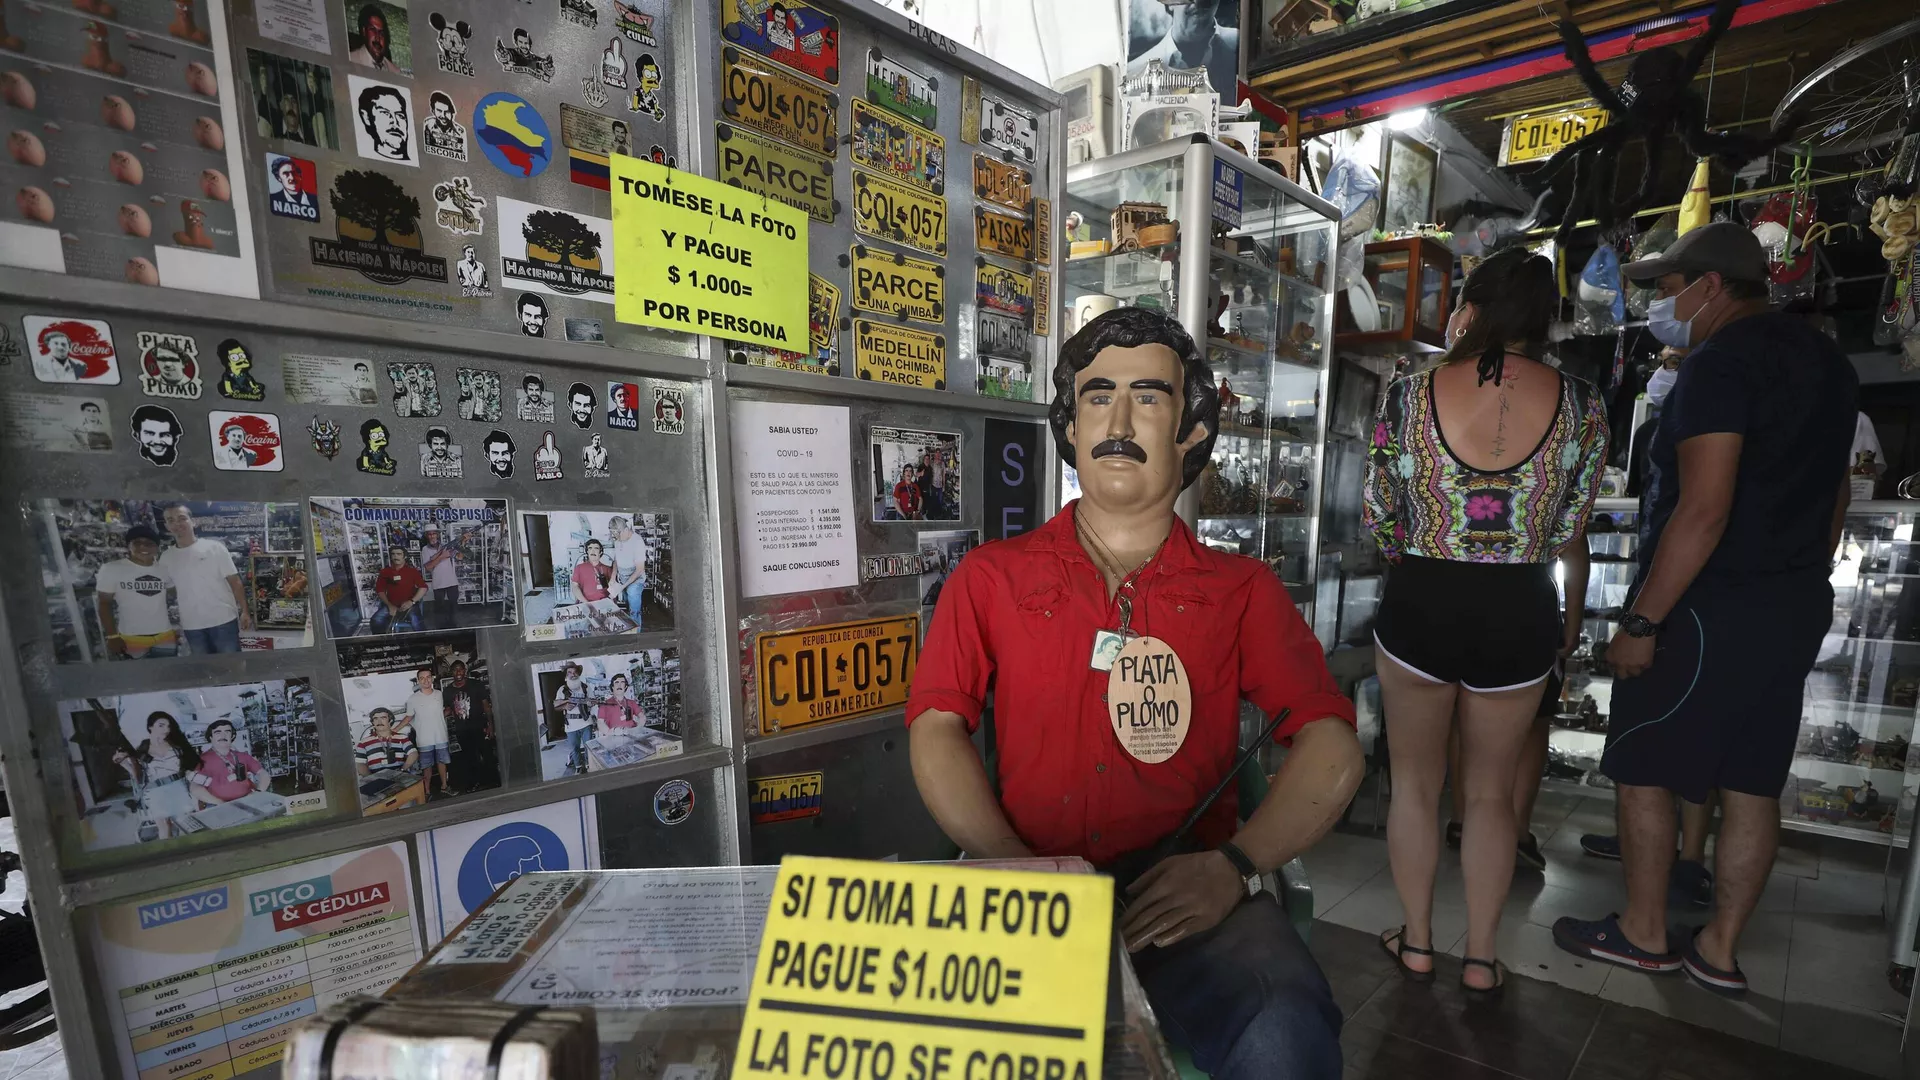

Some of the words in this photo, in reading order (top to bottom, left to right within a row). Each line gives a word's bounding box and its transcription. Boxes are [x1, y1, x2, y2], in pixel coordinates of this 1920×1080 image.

[626, 30, 656, 47] CULITO
[908, 19, 957, 54] PLACAS
[439, 61, 475, 77] POLICE
[788, 78, 820, 96] COLOMBIA
[729, 69, 781, 120] COL
[793, 95, 832, 140] 057
[1155, 96, 1188, 105] HACIENDA
[744, 116, 783, 136] AMERICA
[785, 132, 800, 143] DEL
[804, 138, 820, 151] SUR
[905, 126, 932, 141] COLOMBIA
[992, 128, 1026, 149] COLOMBIA
[1515, 120, 1553, 150] COL
[1561, 114, 1603, 144] 057
[425, 145, 466, 162] ESCOBAR
[784, 149, 816, 164] COLOMBIA
[724, 147, 827, 201] PARCE
[866, 160, 900, 177] AMERICA
[916, 178, 931, 190] SUR
[273, 199, 317, 219] NARCO
[619, 176, 712, 216] TOMESE
[720, 203, 744, 224] LA
[751, 212, 796, 240] FOTO
[907, 191, 933, 204] COLOMBIA
[437, 209, 481, 234] STUNT
[859, 187, 900, 228] COL
[911, 204, 942, 240] 057
[979, 217, 1030, 249] PAISAS
[1039, 203, 1048, 259] COLOMBIA
[661, 229, 677, 248] Y
[684, 235, 752, 267] PAGUE
[919, 242, 932, 251] SUR
[314, 241, 383, 269] HACIENDA
[389, 252, 444, 278] NAPOLES
[505, 259, 566, 282] HACIENDA
[571, 272, 615, 291] NAPOLE
[668, 265, 680, 285] $
[688, 271, 752, 296] 1.000=
[858, 267, 938, 302] PARCE
[980, 272, 1030, 302] COLOMBIA
[307, 287, 453, 312] WWW.HACIENDANAPOLES.COM
[868, 298, 890, 311] UNA
[892, 302, 932, 319] CHIMBA
[1038, 276, 1047, 330] COLOMBIA
[644, 299, 690, 323] POR
[697, 309, 787, 342] PERSONA
[142, 334, 193, 353] PLATA
[907, 332, 932, 342] COLOMBIA
[981, 319, 1002, 347] COL
[1009, 325, 1030, 350] 057
[71, 343, 110, 355] Cocaine
[860, 335, 941, 363] MEDELLÍN
[748, 357, 787, 369] AMERICA
[789, 363, 806, 372] DEL
[808, 366, 824, 375] SUR
[869, 354, 893, 368] UNA
[895, 359, 937, 375] CHIMBA
[148, 380, 198, 397] PLOMO
[882, 370, 923, 386] PARCE
[656, 389, 683, 401] PLATA
[609, 416, 637, 429] NARCO
[656, 421, 682, 434] PLOMO
[769, 426, 790, 434] SABIA
[244, 434, 277, 445] Cocaine
[536, 472, 563, 481] PABLO
[344, 508, 430, 521] COMANDANTE
[436, 508, 493, 520] CASPUSIA
[763, 563, 787, 572] SAQUE
[789, 560, 840, 570] CONCLUSIONES
[866, 555, 923, 579] COLOMBIA
[802, 632, 842, 647] REPUBLICA
[843, 631, 851, 641] DE
[853, 626, 884, 640] COLOMBIA
[768, 647, 840, 706] COL
[853, 635, 913, 691] 057
[1118, 654, 1178, 684] PLATA
[809, 690, 883, 718] SURAMERICA
[1144, 685, 1155, 705] O
[1117, 700, 1179, 729] PLOMO
[789, 782, 819, 809] 057
[142, 892, 224, 924] NUEVO
[254, 883, 315, 913] PICO
[281, 905, 301, 922] &
[307, 887, 383, 917] CÉDULA
[783, 874, 817, 919] SI
[825, 877, 917, 931] TOMA
[927, 884, 970, 931] LA
[981, 888, 1071, 938] FOTO
[515, 911, 548, 939] PABLO
[135, 984, 150, 993] DÍA
[152, 981, 163, 989] LA
[164, 970, 199, 985] SEMANA
[218, 956, 247, 970] DÍGITOS
[250, 953, 259, 961] DE
[271, 942, 299, 956] CÉDULA
[329, 926, 354, 938] RANGO
[356, 917, 386, 931] HORARIO
[765, 940, 881, 993] PAGUE
[889, 949, 1023, 1005] $1.000=
[155, 988, 179, 1000] LUNES
[150, 1013, 195, 1031] MIÉRCOLES
[155, 1003, 187, 1017] MARTES
[166, 1025, 194, 1039] JUEVES
[165, 1042, 197, 1057] VIERNES
[168, 1058, 202, 1075] SÁBADO
[239, 1036, 269, 1050] Cédulas
[748, 1028, 789, 1075] LA
[802, 1033, 895, 1080] FOTO
[906, 1044, 953, 1080] SE
